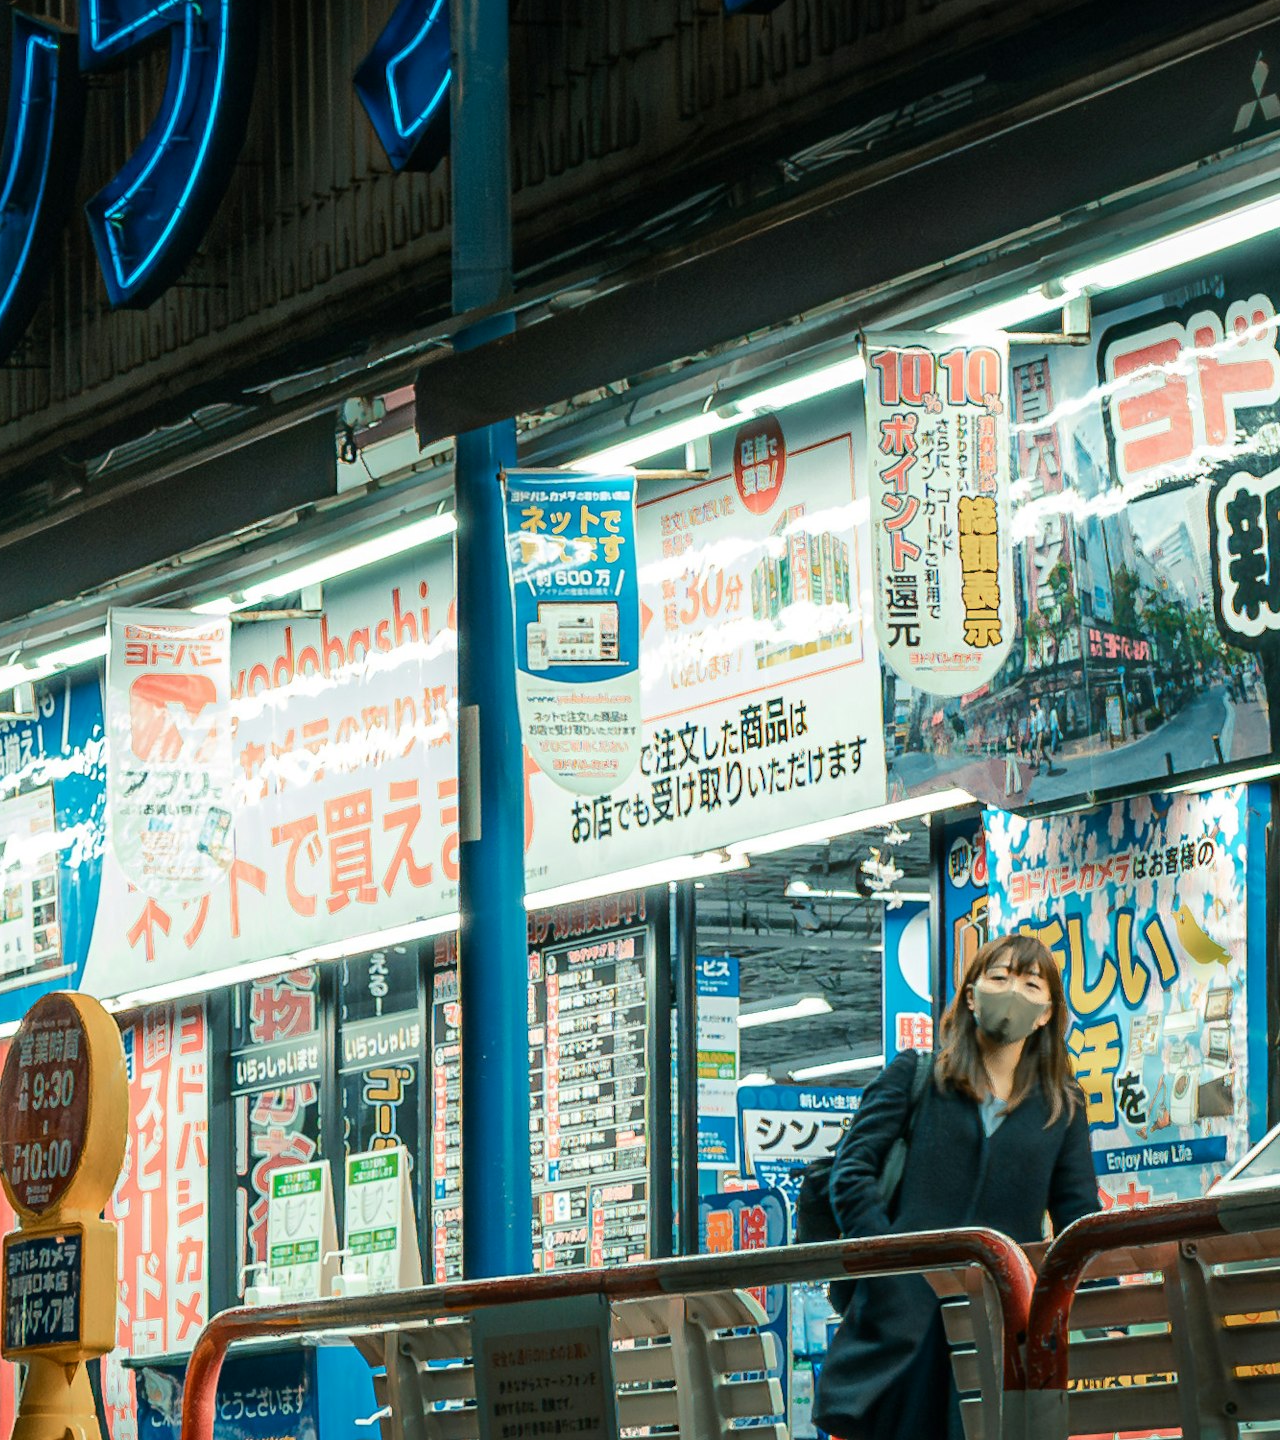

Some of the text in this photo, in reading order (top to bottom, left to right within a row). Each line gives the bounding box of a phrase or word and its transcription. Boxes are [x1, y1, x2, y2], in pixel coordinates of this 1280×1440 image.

[520, 505, 622, 536] ネットで
[876, 411, 923, 650] ポイント還元
[919, 429, 942, 621] ポイントカードご利用で
[536, 568, 611, 589] 約600万
[124, 641, 223, 667] ヨドバシ
[526, 693, 633, 706] www.yodobashi.com
[533, 711, 629, 724] ネットで注文した商品は
[528, 725, 637, 737] お店で受け取りいただけます
[639, 696, 809, 779] で注文した商品は
[570, 735, 869, 845] お店でも受け取りいただけます
[1010, 837, 1217, 906] ヨドバシカメラはお客様の
[18, 1027, 80, 1068] 営業時間
[235, 1043, 321, 1086] いらっしゃいませ
[31, 1069, 76, 1109] 9:30
[20, 1138, 73, 1182] 10:00
[1105, 1143, 1194, 1172] Enjoy New Life
